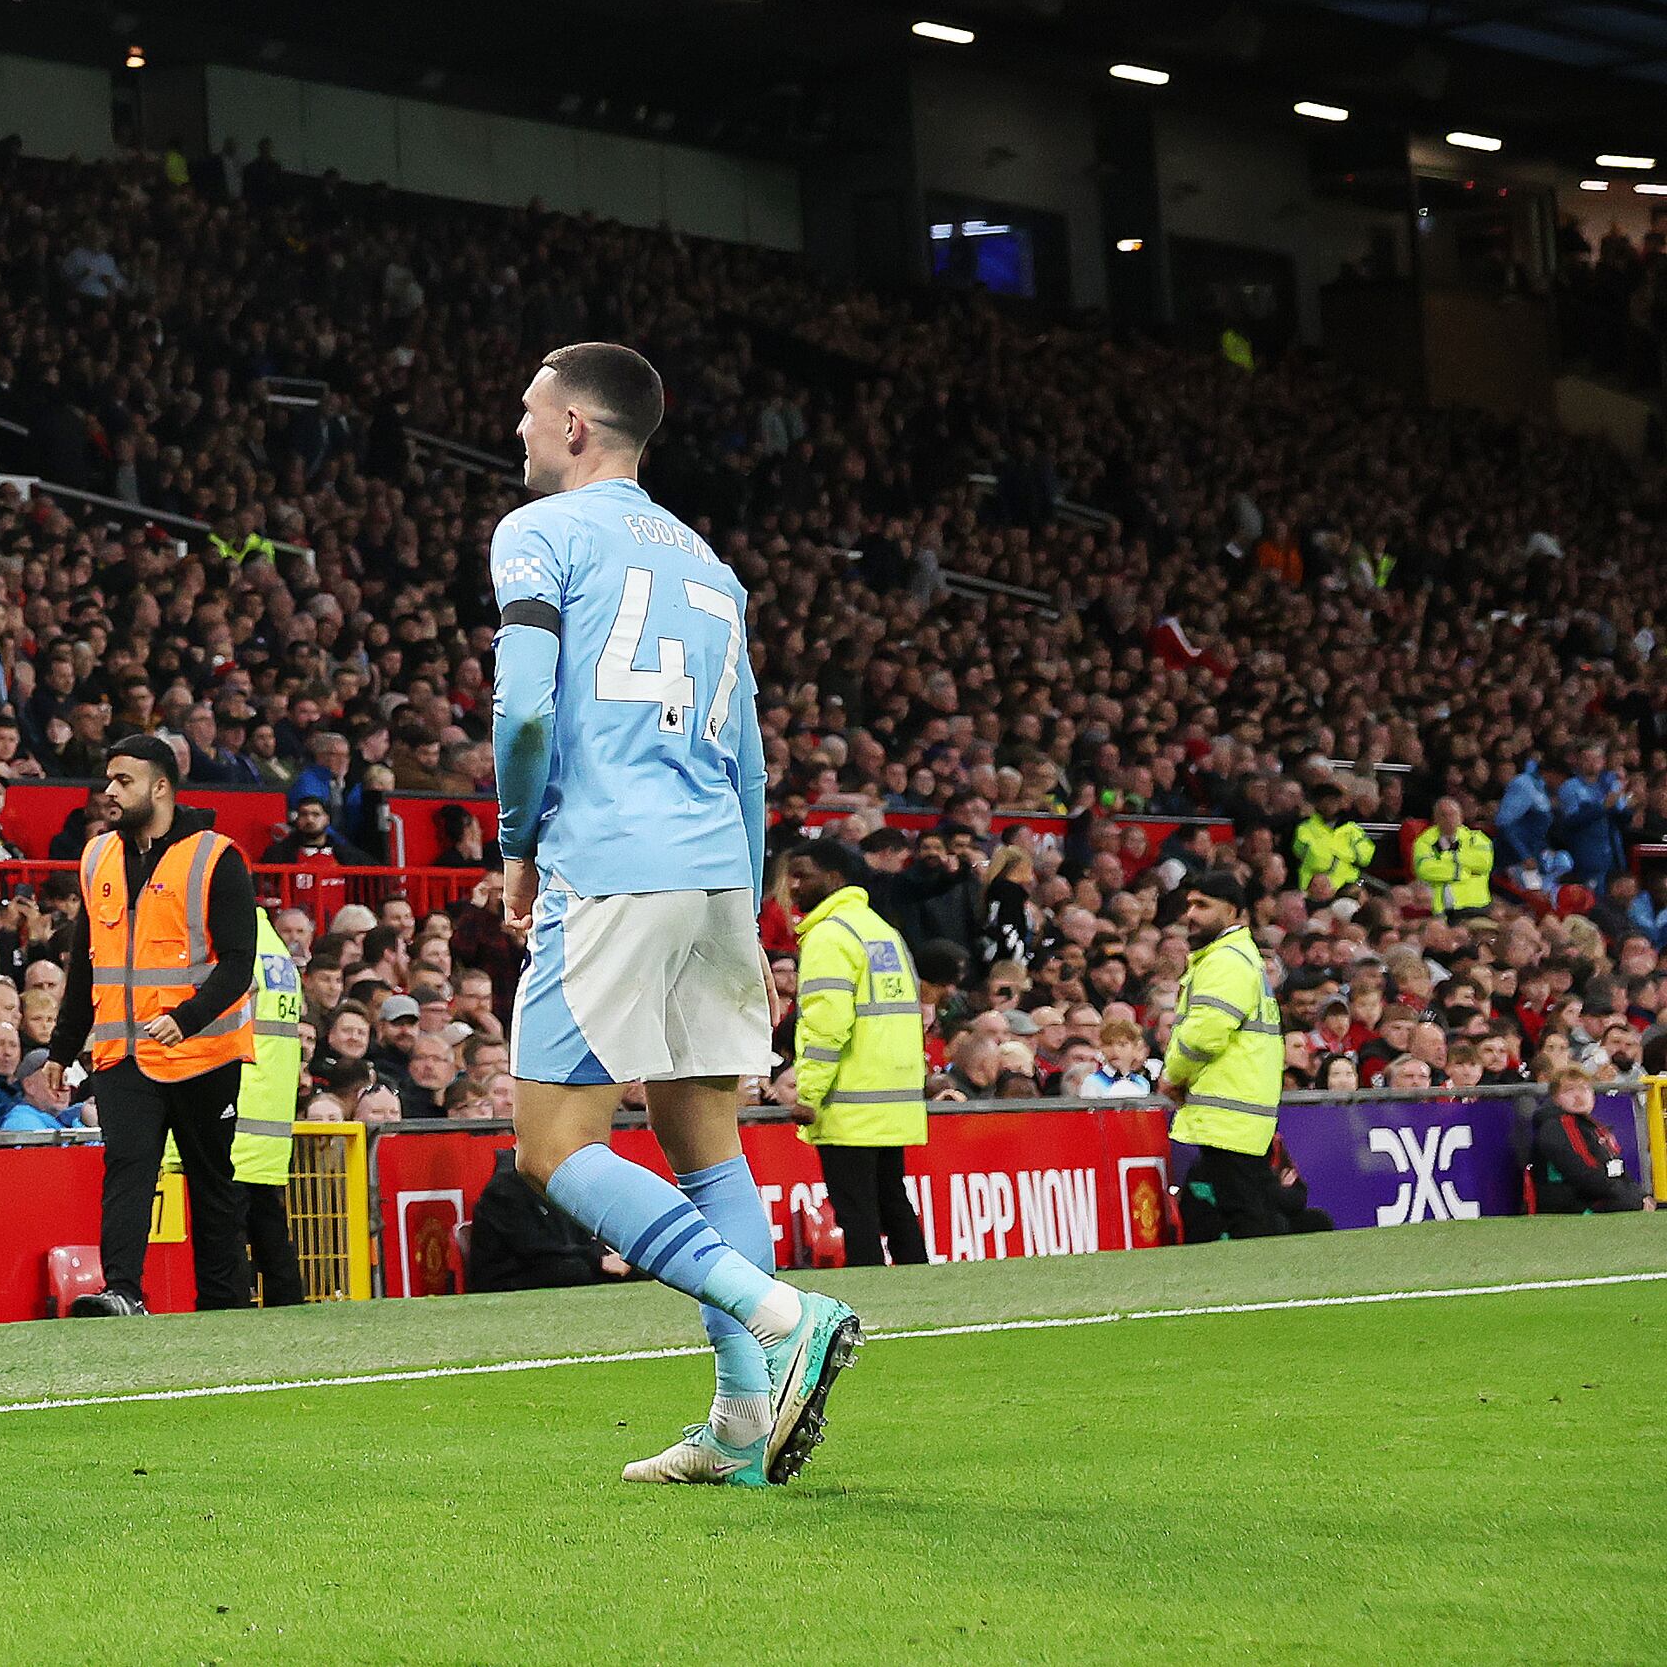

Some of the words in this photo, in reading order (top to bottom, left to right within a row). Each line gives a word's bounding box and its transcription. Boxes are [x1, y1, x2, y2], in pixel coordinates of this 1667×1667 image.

[623, 514, 711, 566] FODEN
[595, 565, 742, 741] 47
[950, 1172, 1015, 1263] APP
[1016, 1168, 1100, 1259] NOW
